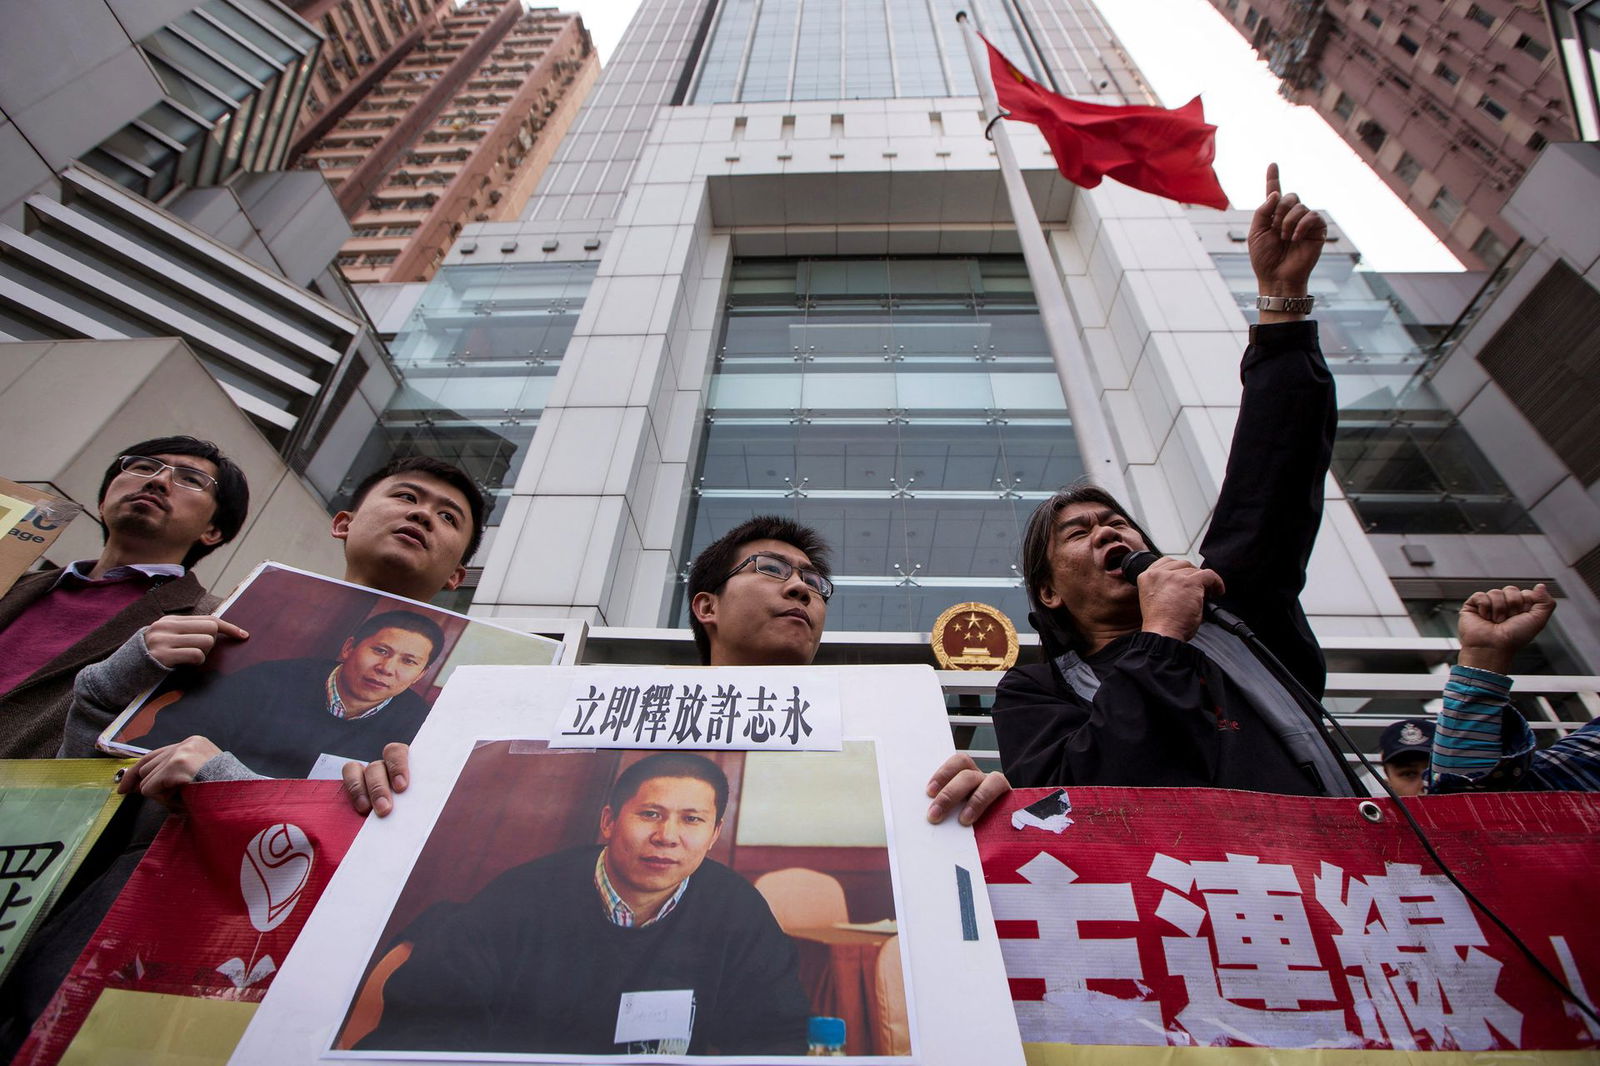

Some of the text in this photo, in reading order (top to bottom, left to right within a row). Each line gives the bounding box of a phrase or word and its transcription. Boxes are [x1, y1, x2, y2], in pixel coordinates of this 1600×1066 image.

[562, 683, 813, 745] 立即釋放許志永
